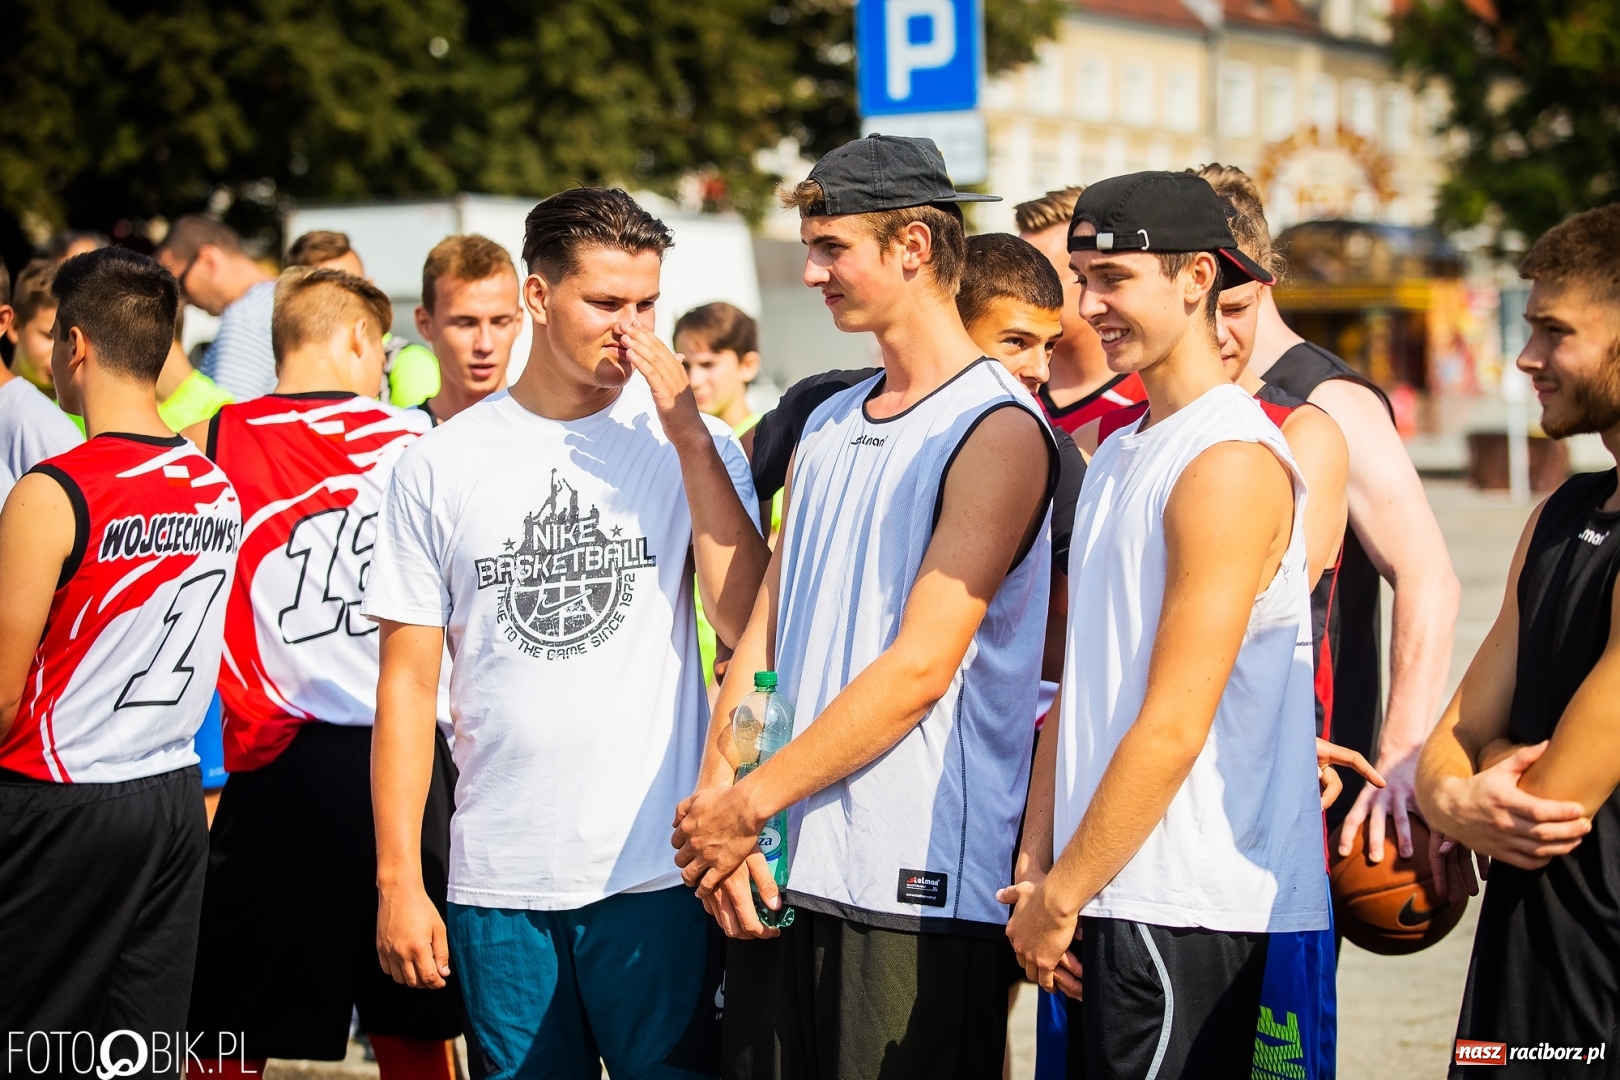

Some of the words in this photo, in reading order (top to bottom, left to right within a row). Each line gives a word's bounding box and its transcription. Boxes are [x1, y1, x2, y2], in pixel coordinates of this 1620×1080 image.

[885, 0, 956, 101] P
[100, 515, 239, 560] WOJCIECHOWS
[476, 538, 656, 589] BASKETBALL
[532, 518, 599, 551] NIKE
[114, 569, 226, 712] 1
[503, 623, 518, 643] TO
[518, 638, 544, 659] THE
[546, 642, 588, 661] GAME
[590, 611, 626, 648] SINCE
[619, 572, 636, 607] 1972
